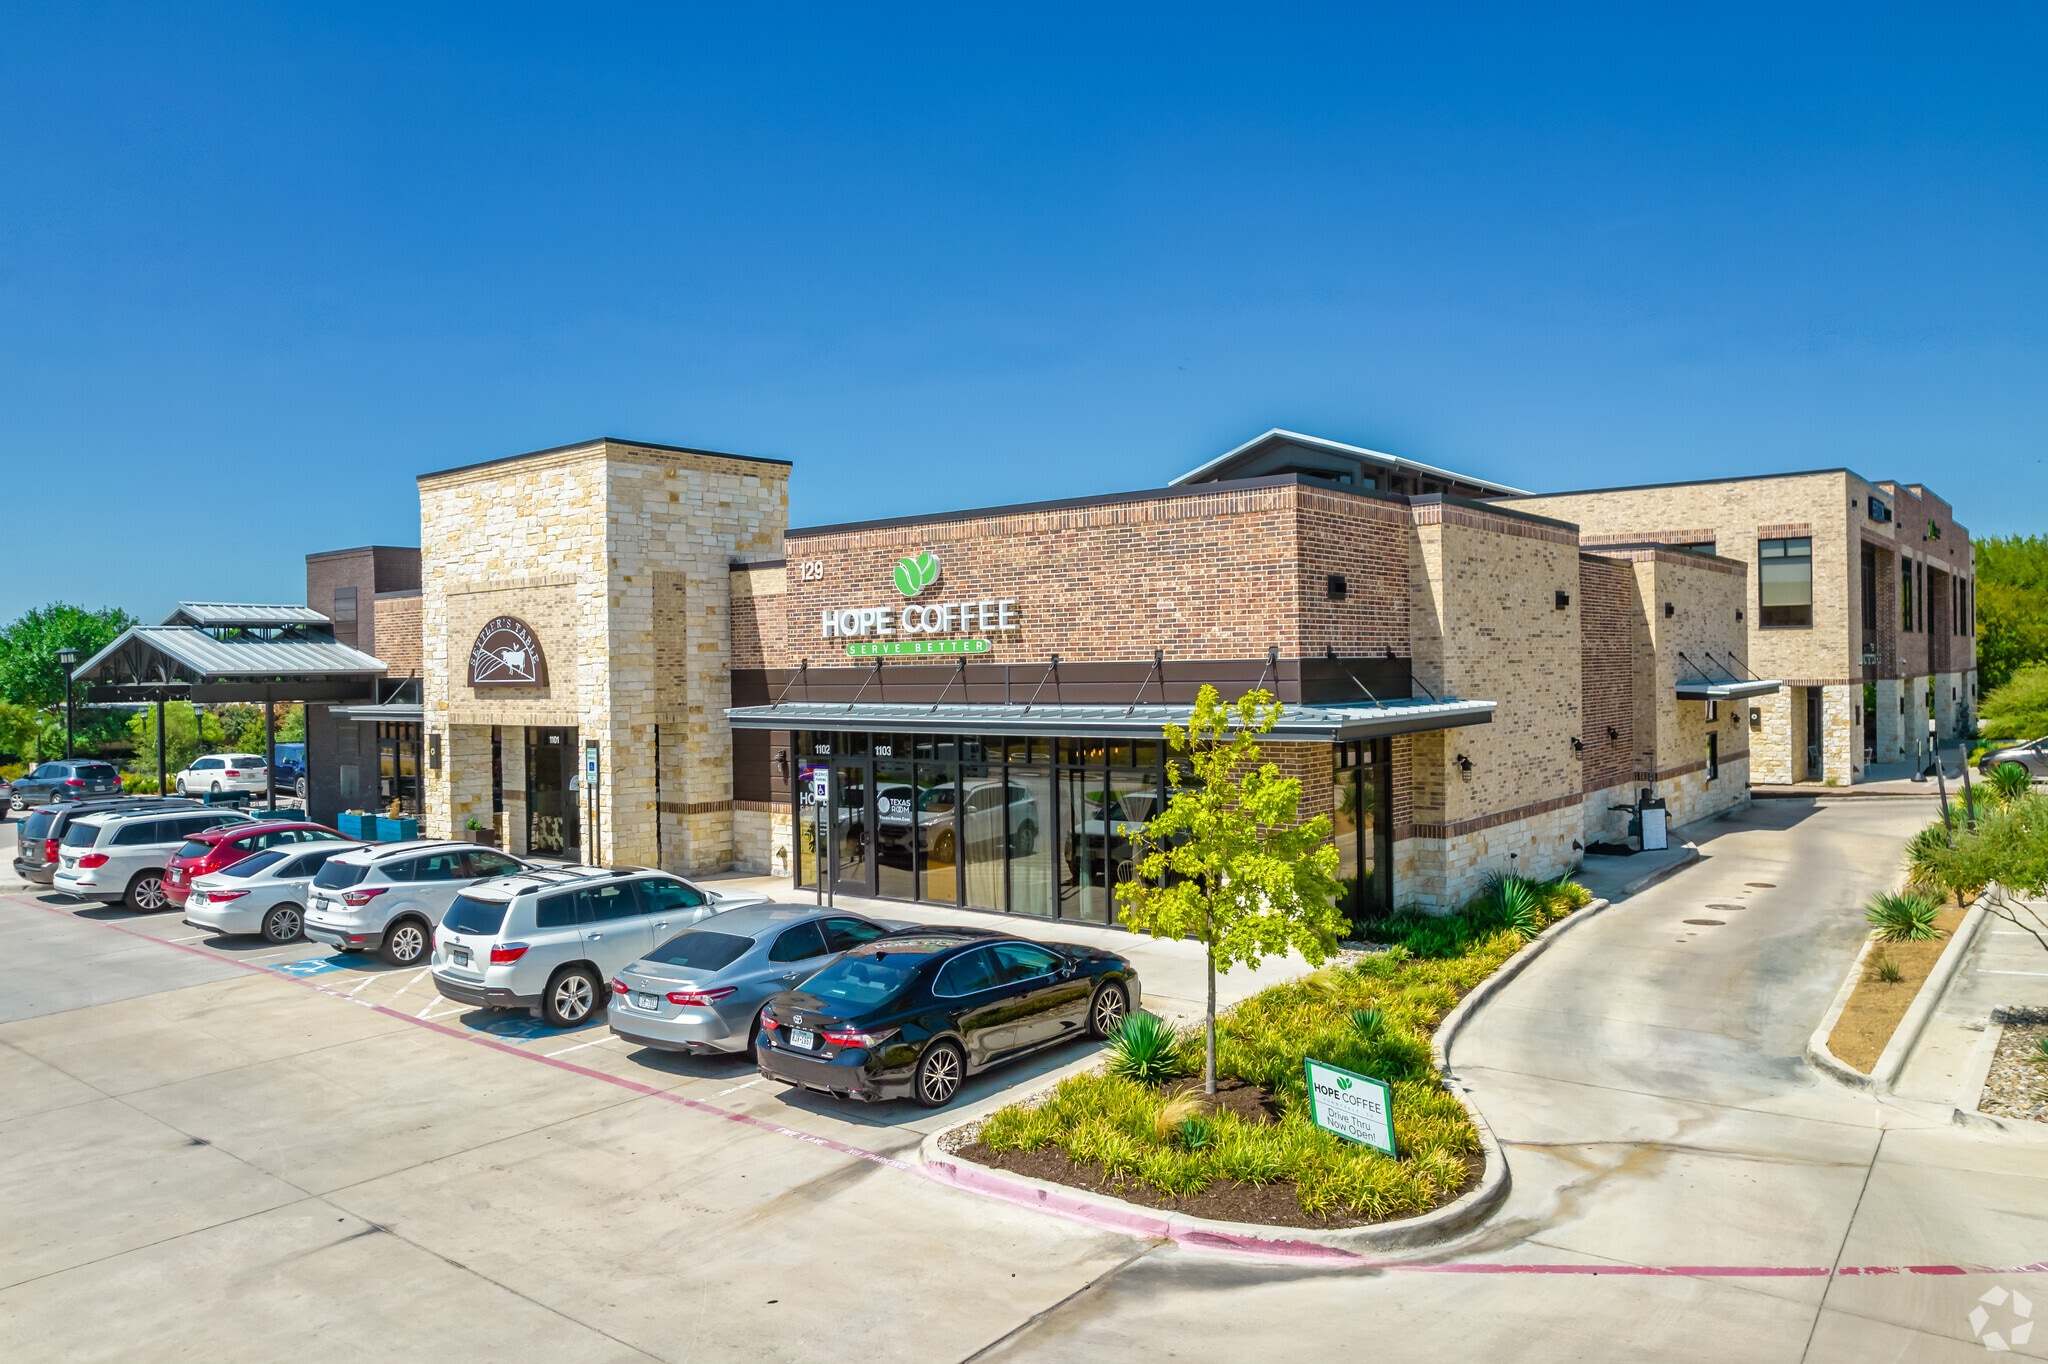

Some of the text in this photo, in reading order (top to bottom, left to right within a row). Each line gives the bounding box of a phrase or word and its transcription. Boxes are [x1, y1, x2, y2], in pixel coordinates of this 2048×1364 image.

[800, 560, 824, 581] 129
[822, 599, 1020, 638] HOPE COFFEE
[470, 618, 540, 667] SETTLER'S TABLE
[850, 641, 983, 655] SERVE BETTER
[815, 744, 830, 754] 1102
[875, 746, 891, 755] 1103
[1314, 1082, 1340, 1100] HOPE
[1342, 1092, 1382, 1114] COFFEE
[1327, 1116, 1376, 1142] Now Open!
[1328, 1107, 1371, 1131] Drive Thru
